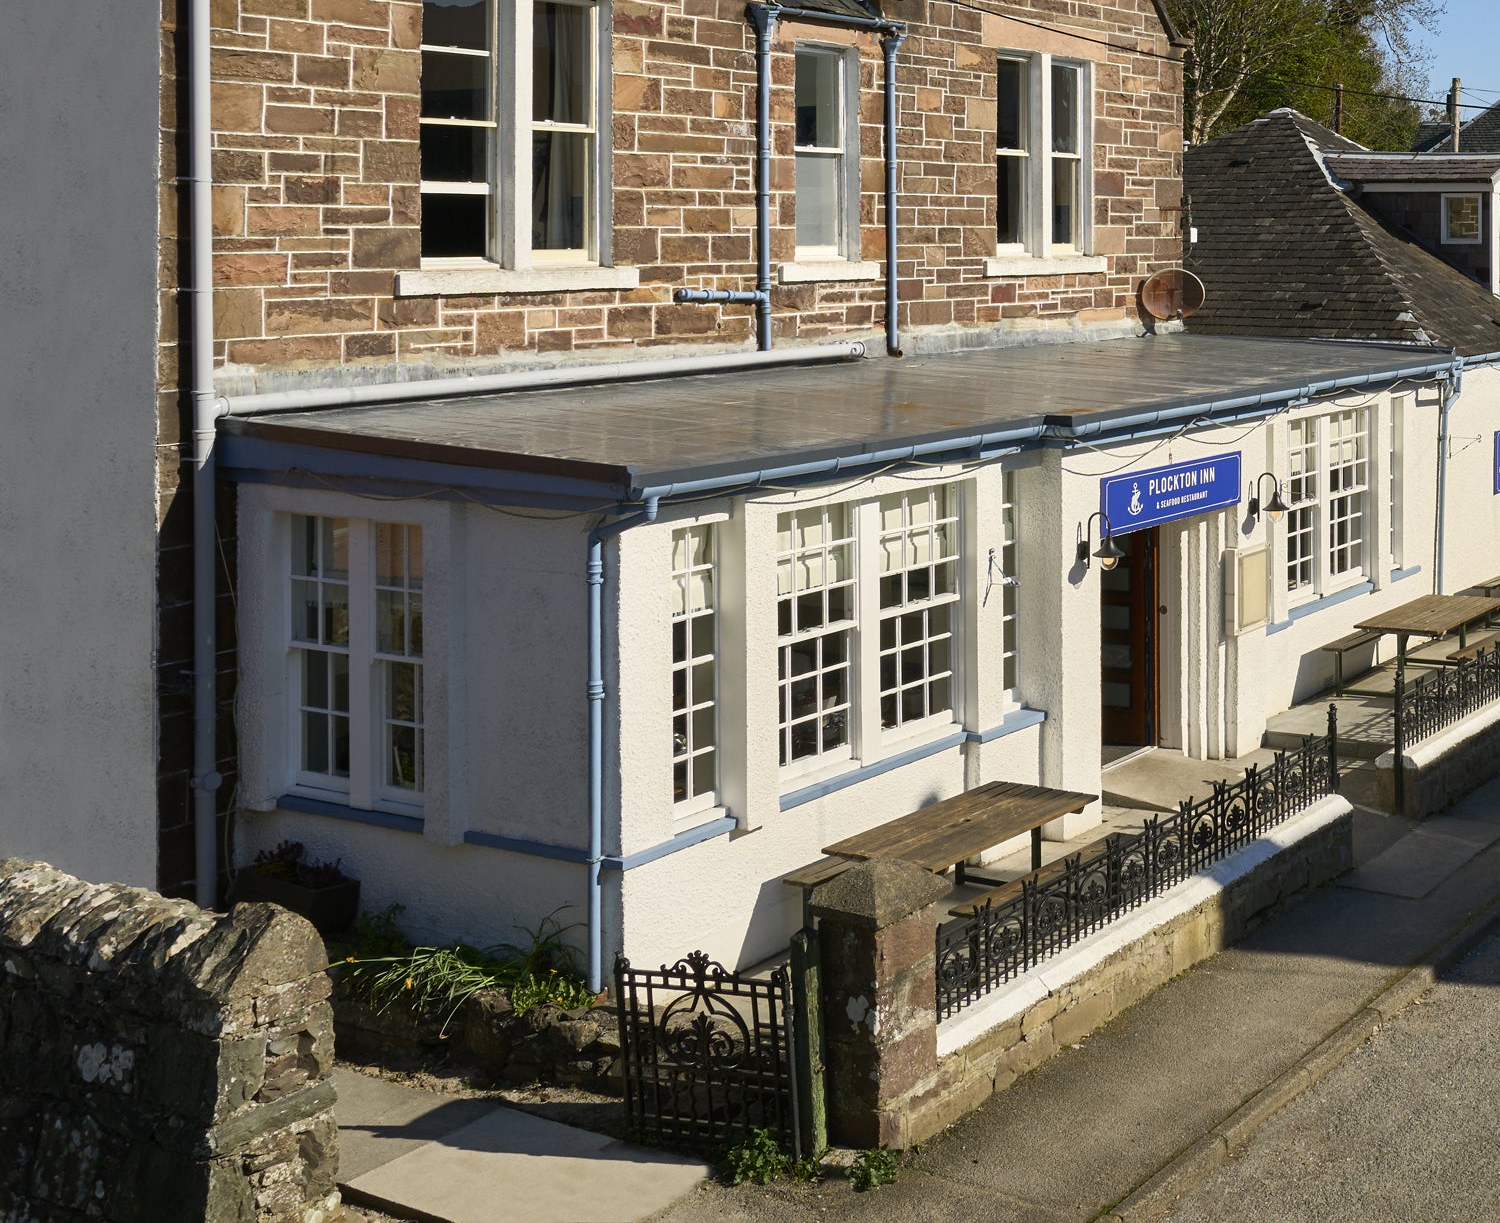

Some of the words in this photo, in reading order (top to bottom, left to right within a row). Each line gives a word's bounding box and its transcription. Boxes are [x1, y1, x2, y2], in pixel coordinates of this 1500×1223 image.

[1149, 471, 1197, 495] PLOCKTON
[1200, 467, 1215, 484] INN
[1160, 497, 1180, 508] SEAFOOD
[1181, 490, 1208, 503] RESTAURANT
